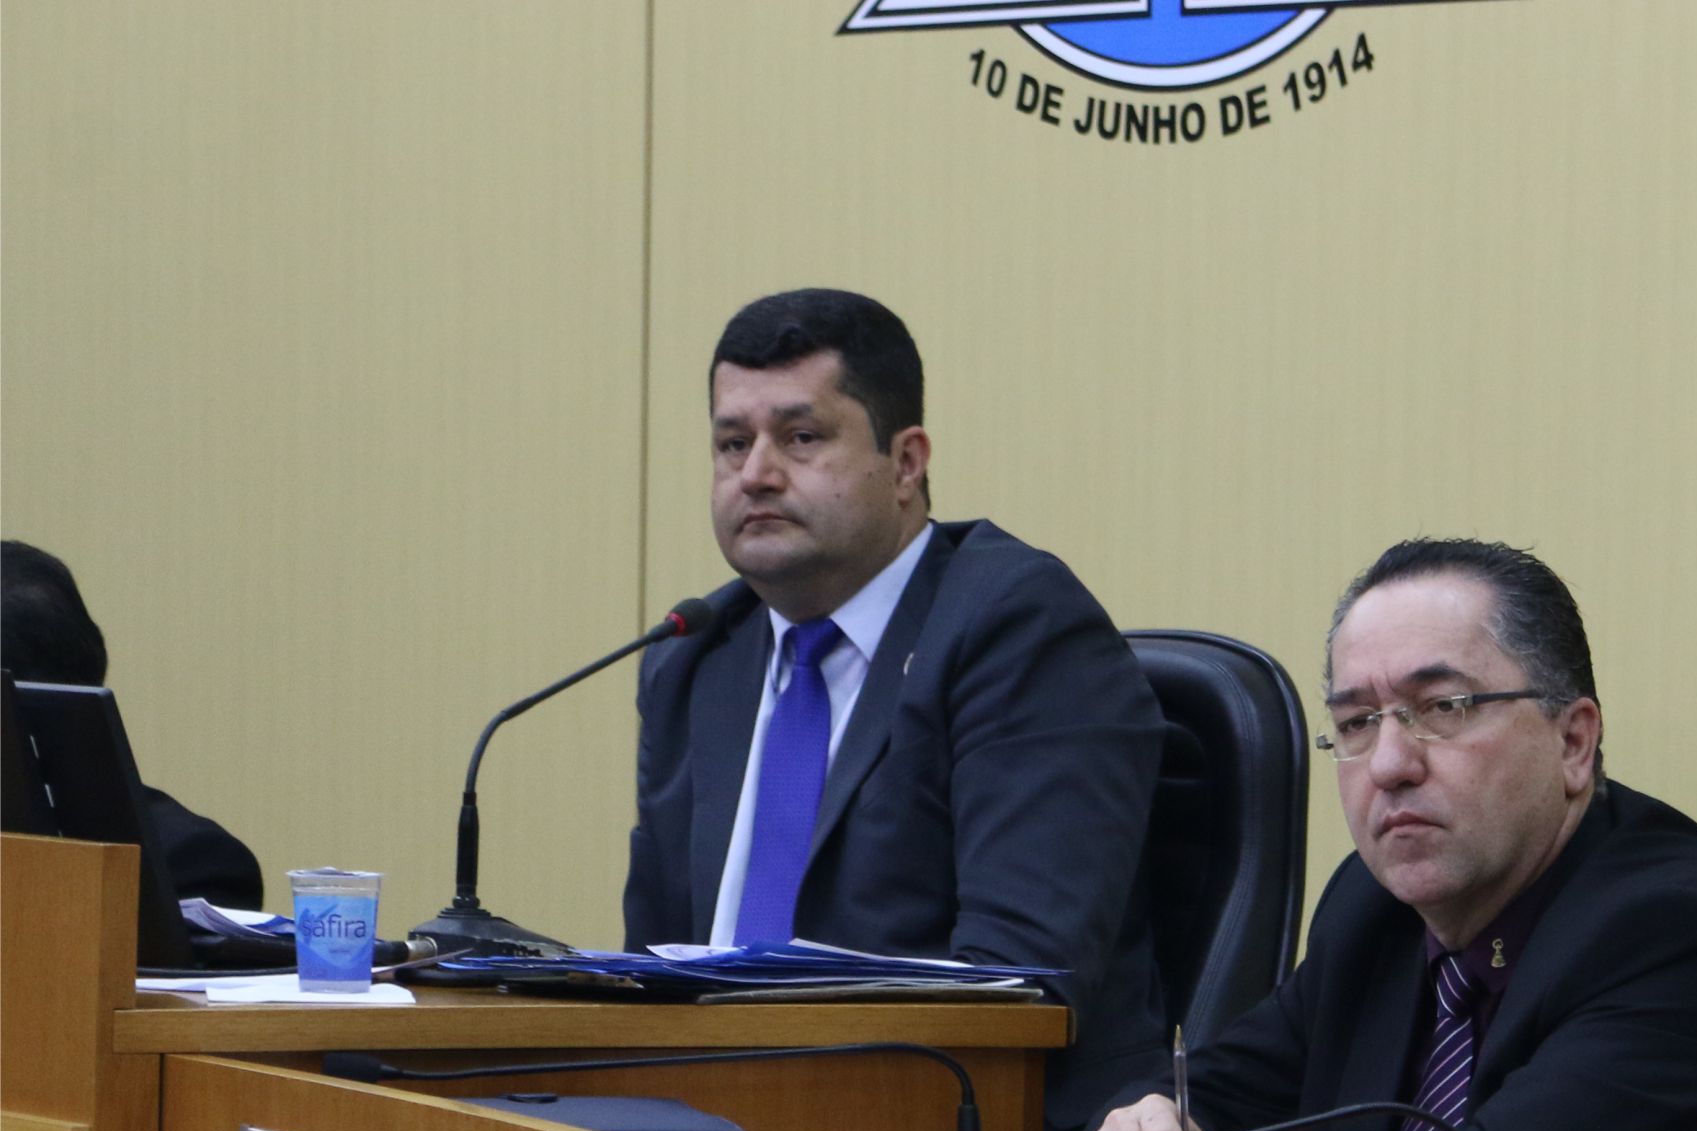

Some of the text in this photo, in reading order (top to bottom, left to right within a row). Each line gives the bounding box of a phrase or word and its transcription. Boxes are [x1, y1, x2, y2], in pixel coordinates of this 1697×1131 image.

[968, 33, 1375, 145] 10 DE JUNHO DE 1914
[302, 914, 367, 938] safira
